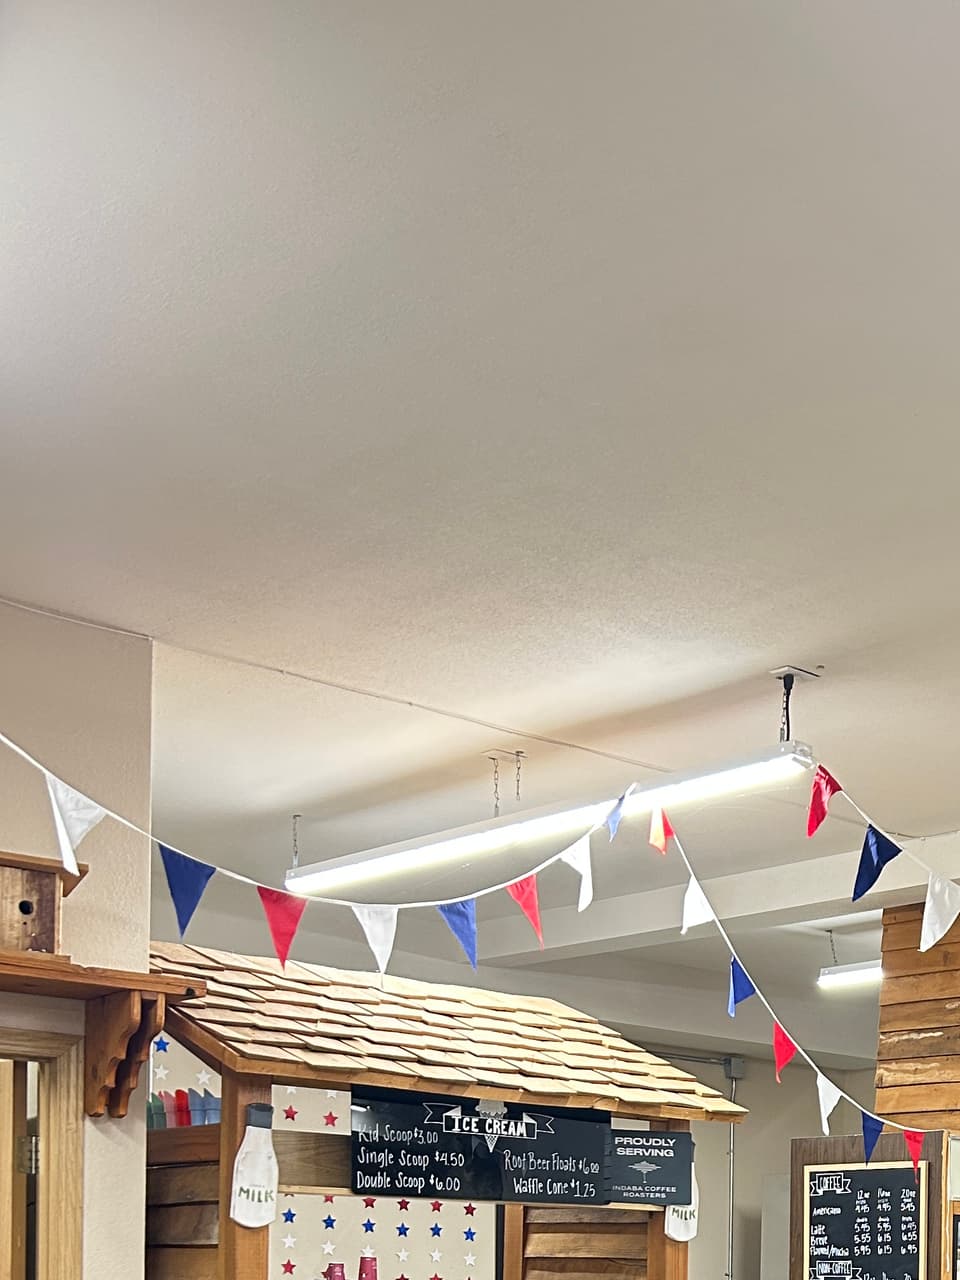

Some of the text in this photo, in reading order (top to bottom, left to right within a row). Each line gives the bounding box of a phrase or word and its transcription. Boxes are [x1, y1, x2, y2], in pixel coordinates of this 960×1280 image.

[358, 1123, 439, 1145] Kid Scoop $3.00
[452, 1116, 527, 1137] ICE CREAM
[615, 1136, 676, 1147] PROUDLY
[357, 1147, 465, 1171] Single Scoop $4.50
[617, 1147, 674, 1157] SERVING
[504, 1150, 526, 1171] Root
[529, 1152, 549, 1171] Beer
[552, 1153, 576, 1172] Floats
[357, 1171, 460, 1194] Double Scoop $6.00
[513, 1177, 543, 1194] Waffle
[547, 1178, 569, 1195] Cone
[819, 1175, 841, 1189] COFFEE
[238, 1187, 274, 1203] MILK
[623, 1191, 667, 1199] ROASTERS
[672, 1207, 696, 1220] MILK
